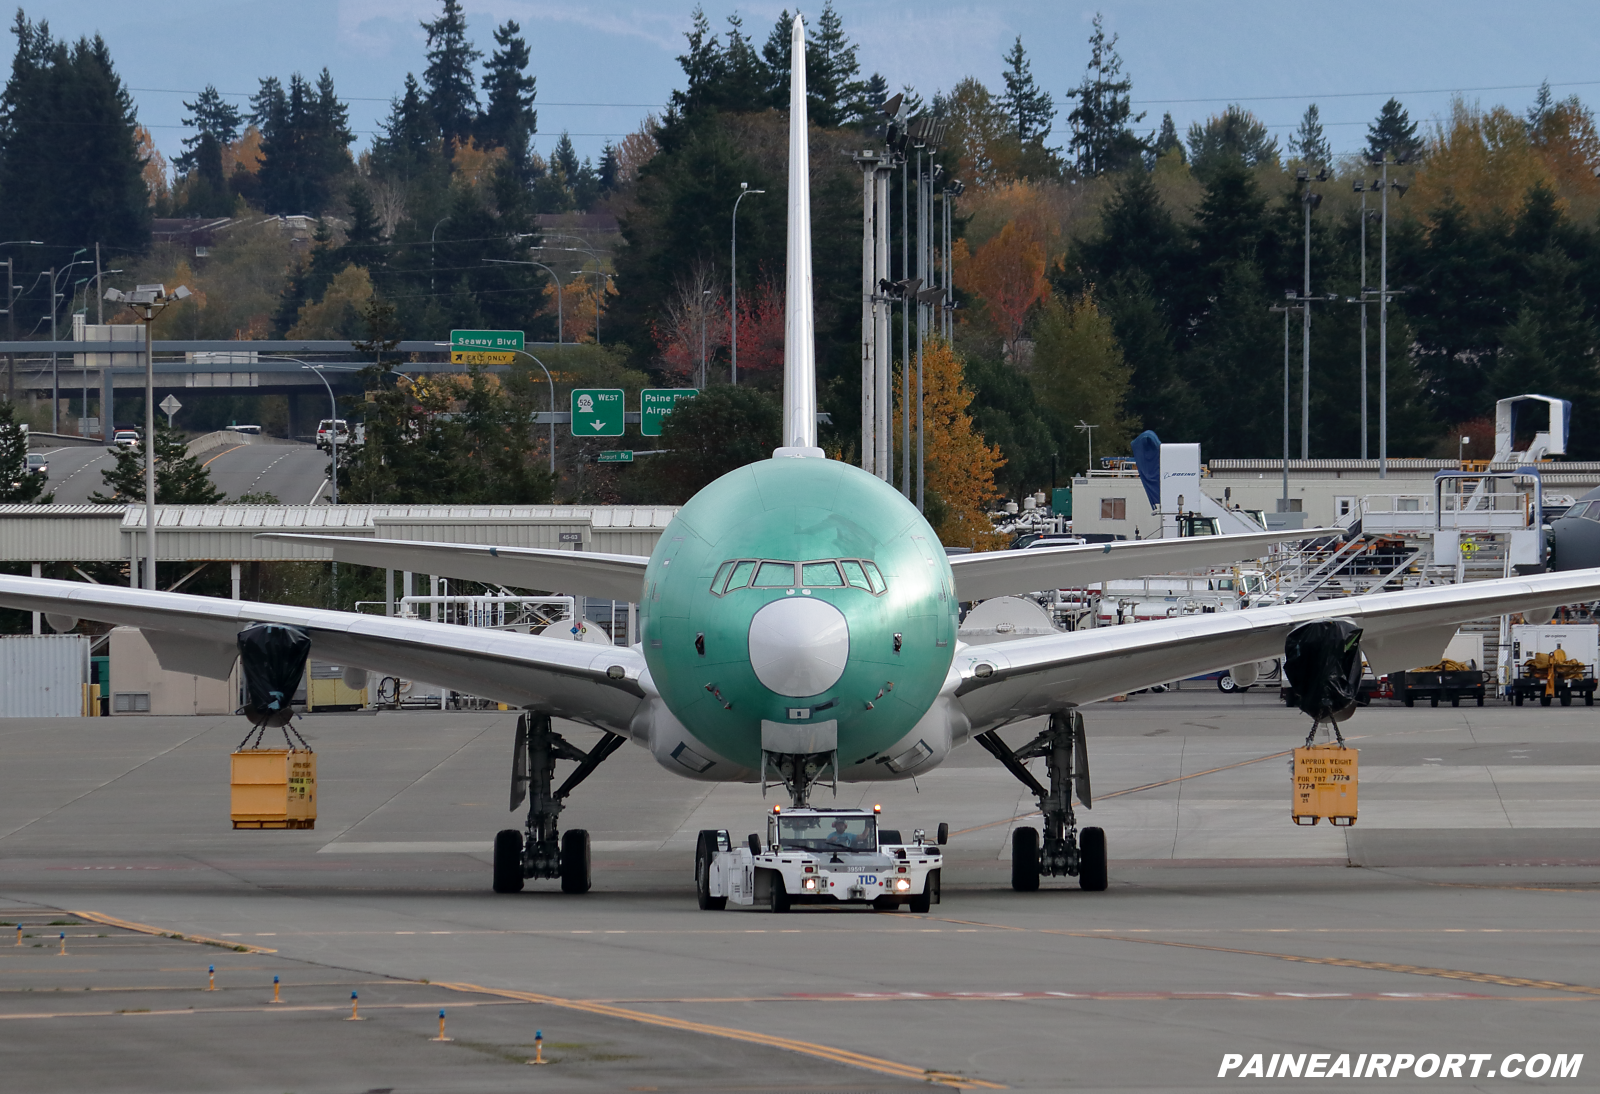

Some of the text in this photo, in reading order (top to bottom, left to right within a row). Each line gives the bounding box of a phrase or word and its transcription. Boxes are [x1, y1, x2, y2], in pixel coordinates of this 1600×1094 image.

[458, 337, 517, 347] Seaway Blvd
[598, 393, 619, 401] WEST
[645, 394, 671, 402] Paine
[579, 399, 592, 407] 526
[620, 452, 629, 460] Rd
[1329, 758, 1352, 766] WEIGHT
[859, 875, 877, 885] TLD
